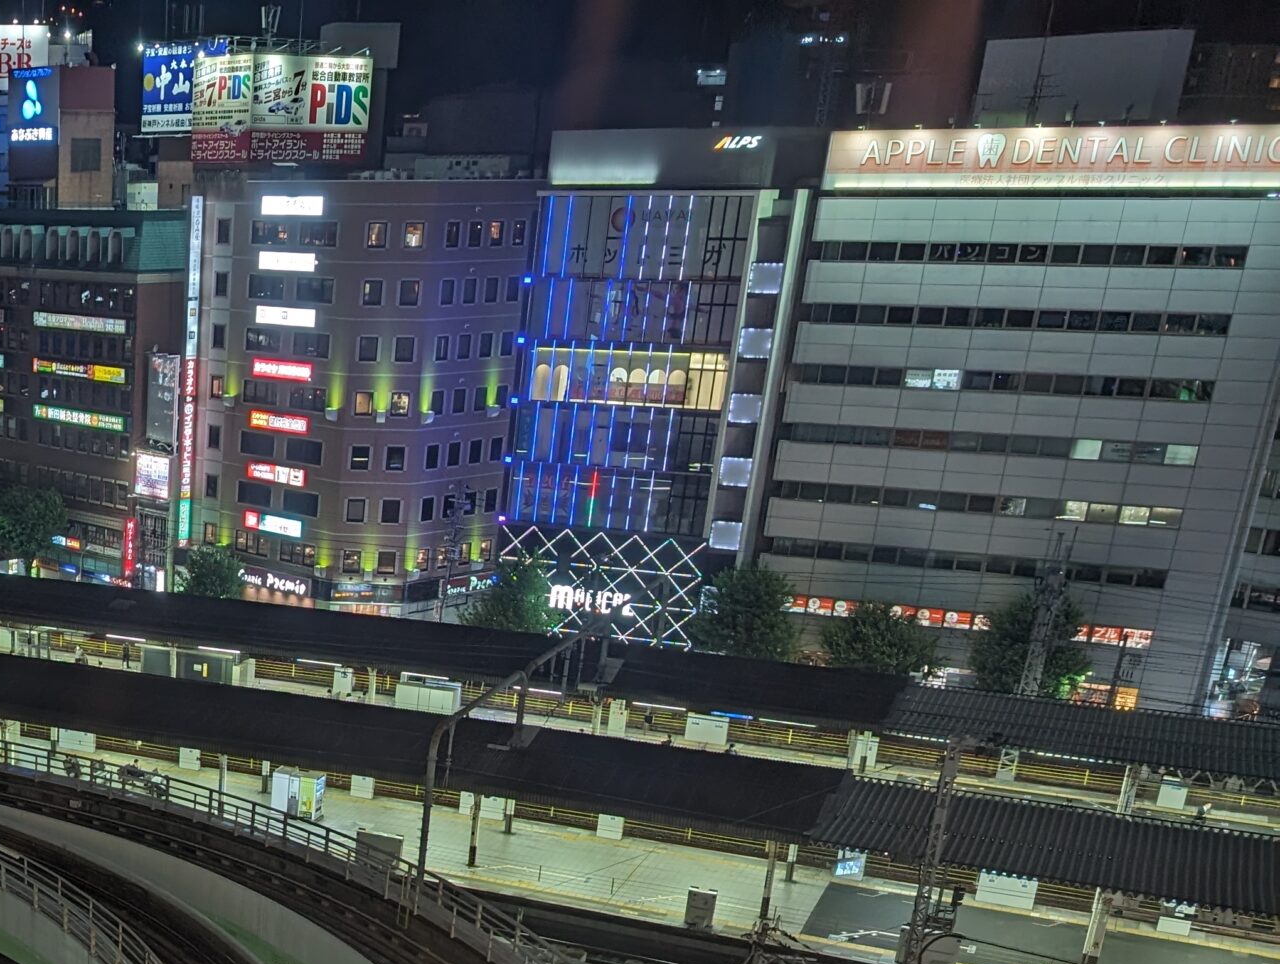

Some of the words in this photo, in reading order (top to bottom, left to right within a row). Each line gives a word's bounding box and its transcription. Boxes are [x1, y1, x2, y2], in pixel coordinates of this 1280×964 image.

[714, 135, 763, 149] ALPS
[860, 138, 968, 166] APPLE
[1011, 136, 1152, 165] DENTAL
[934, 245, 1041, 261] パソコン
